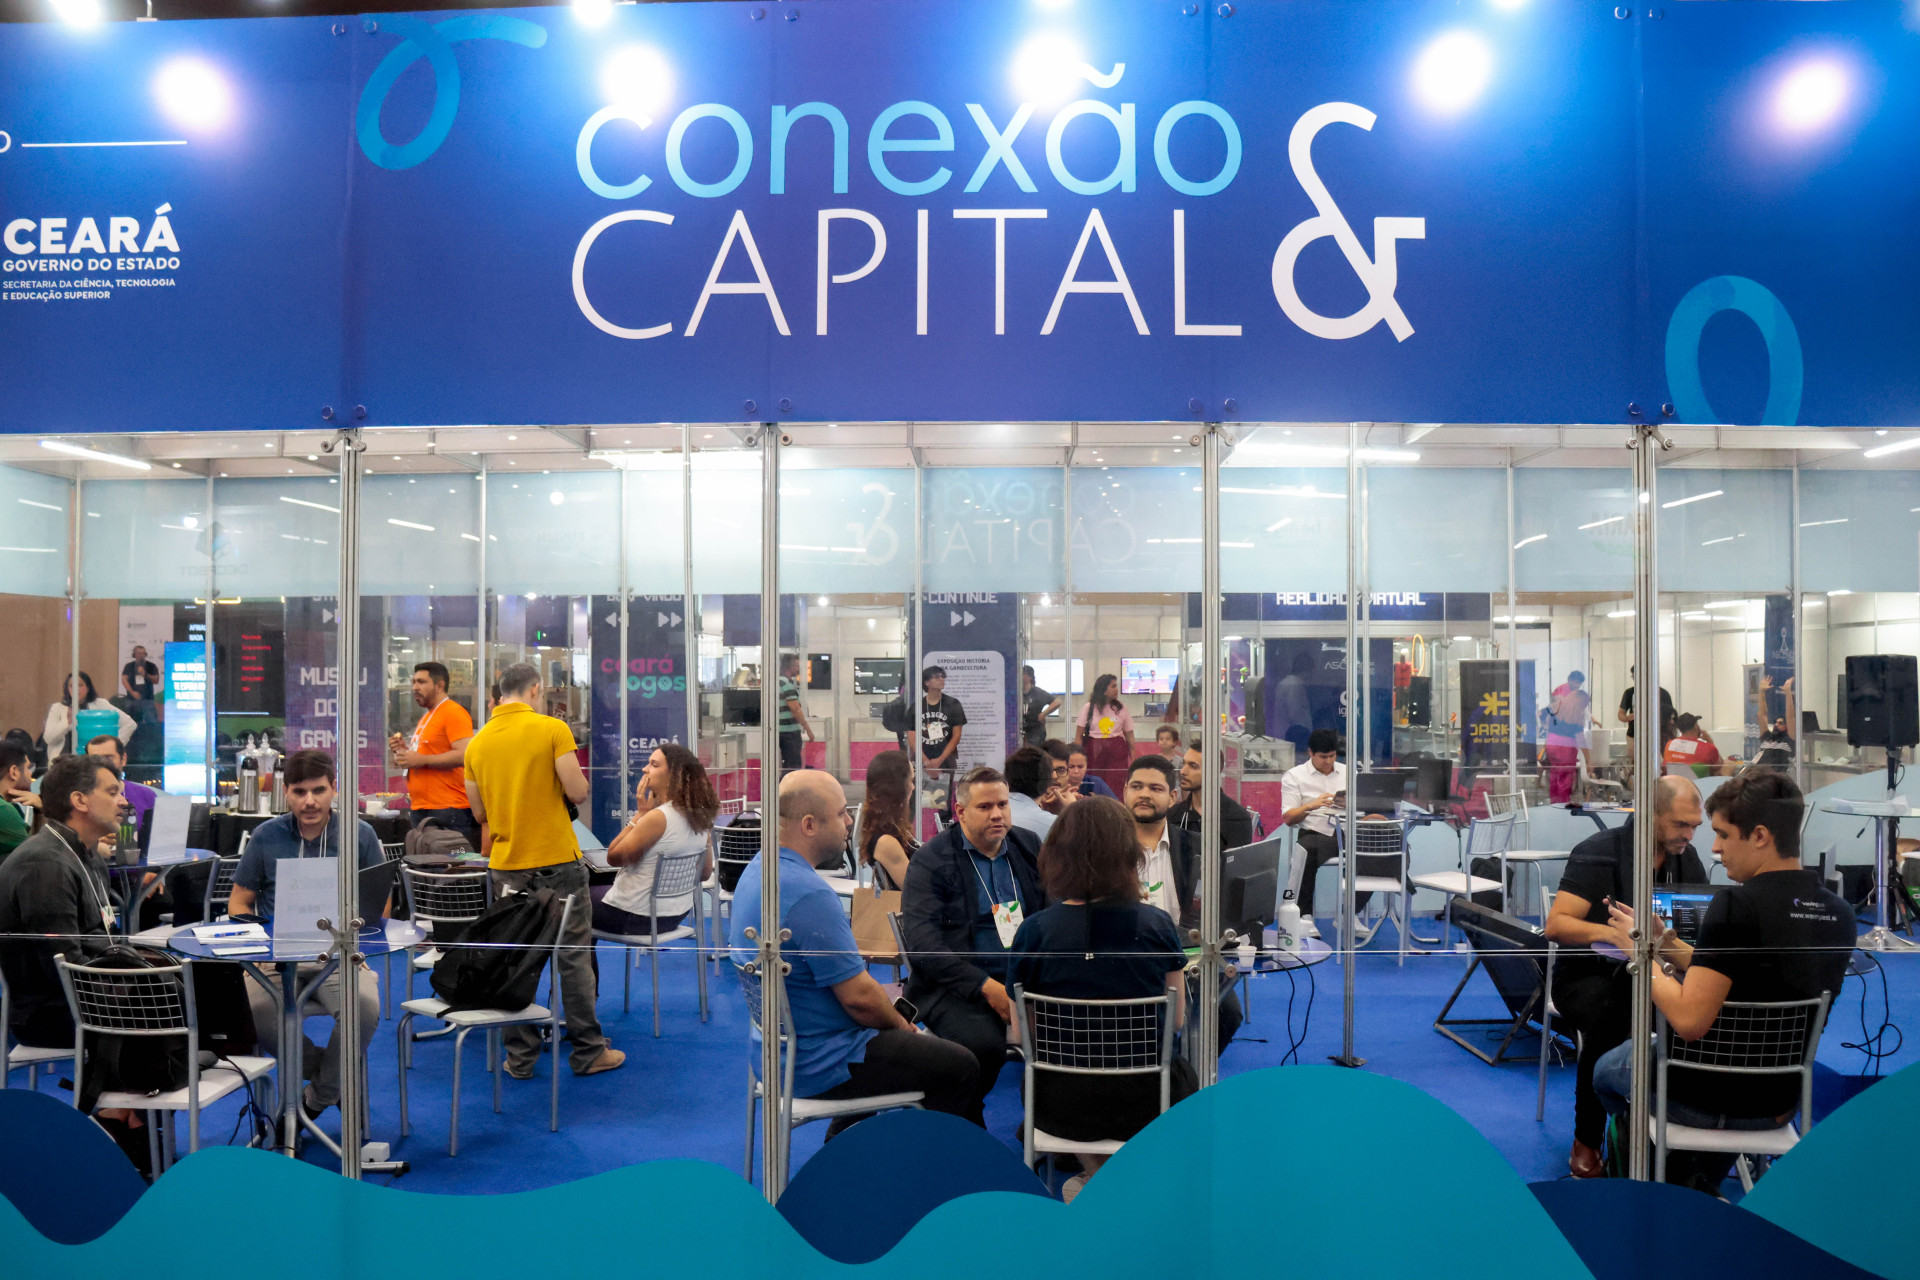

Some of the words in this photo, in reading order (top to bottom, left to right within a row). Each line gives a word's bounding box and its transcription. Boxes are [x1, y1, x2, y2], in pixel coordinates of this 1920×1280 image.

[575, 62, 1242, 200] conexão
[3, 202, 181, 255] CEARÁ
[1272, 101, 1426, 343] &
[3, 259, 84, 272] GOVERNO
[88, 258, 112, 271] DO
[117, 257, 181, 270] ESTADO
[572, 208, 1242, 340] CAPITAL
[3, 280, 57, 289] SECRETARIA
[59, 280, 72, 288] DA
[74, 278, 114, 288] CIÊNCIA,
[116, 278, 175, 287] TECNOLOGIA
[3, 292, 8, 300] E
[11, 290, 62, 302] EDUCAÇÃO
[64, 291, 111, 299] SUPERIOR
[1276, 591, 1359, 606] REALIDAD
[300, 667, 367, 686] MUSU
[616, 675, 686, 699] ogos
[300, 729, 367, 748] GAMS
